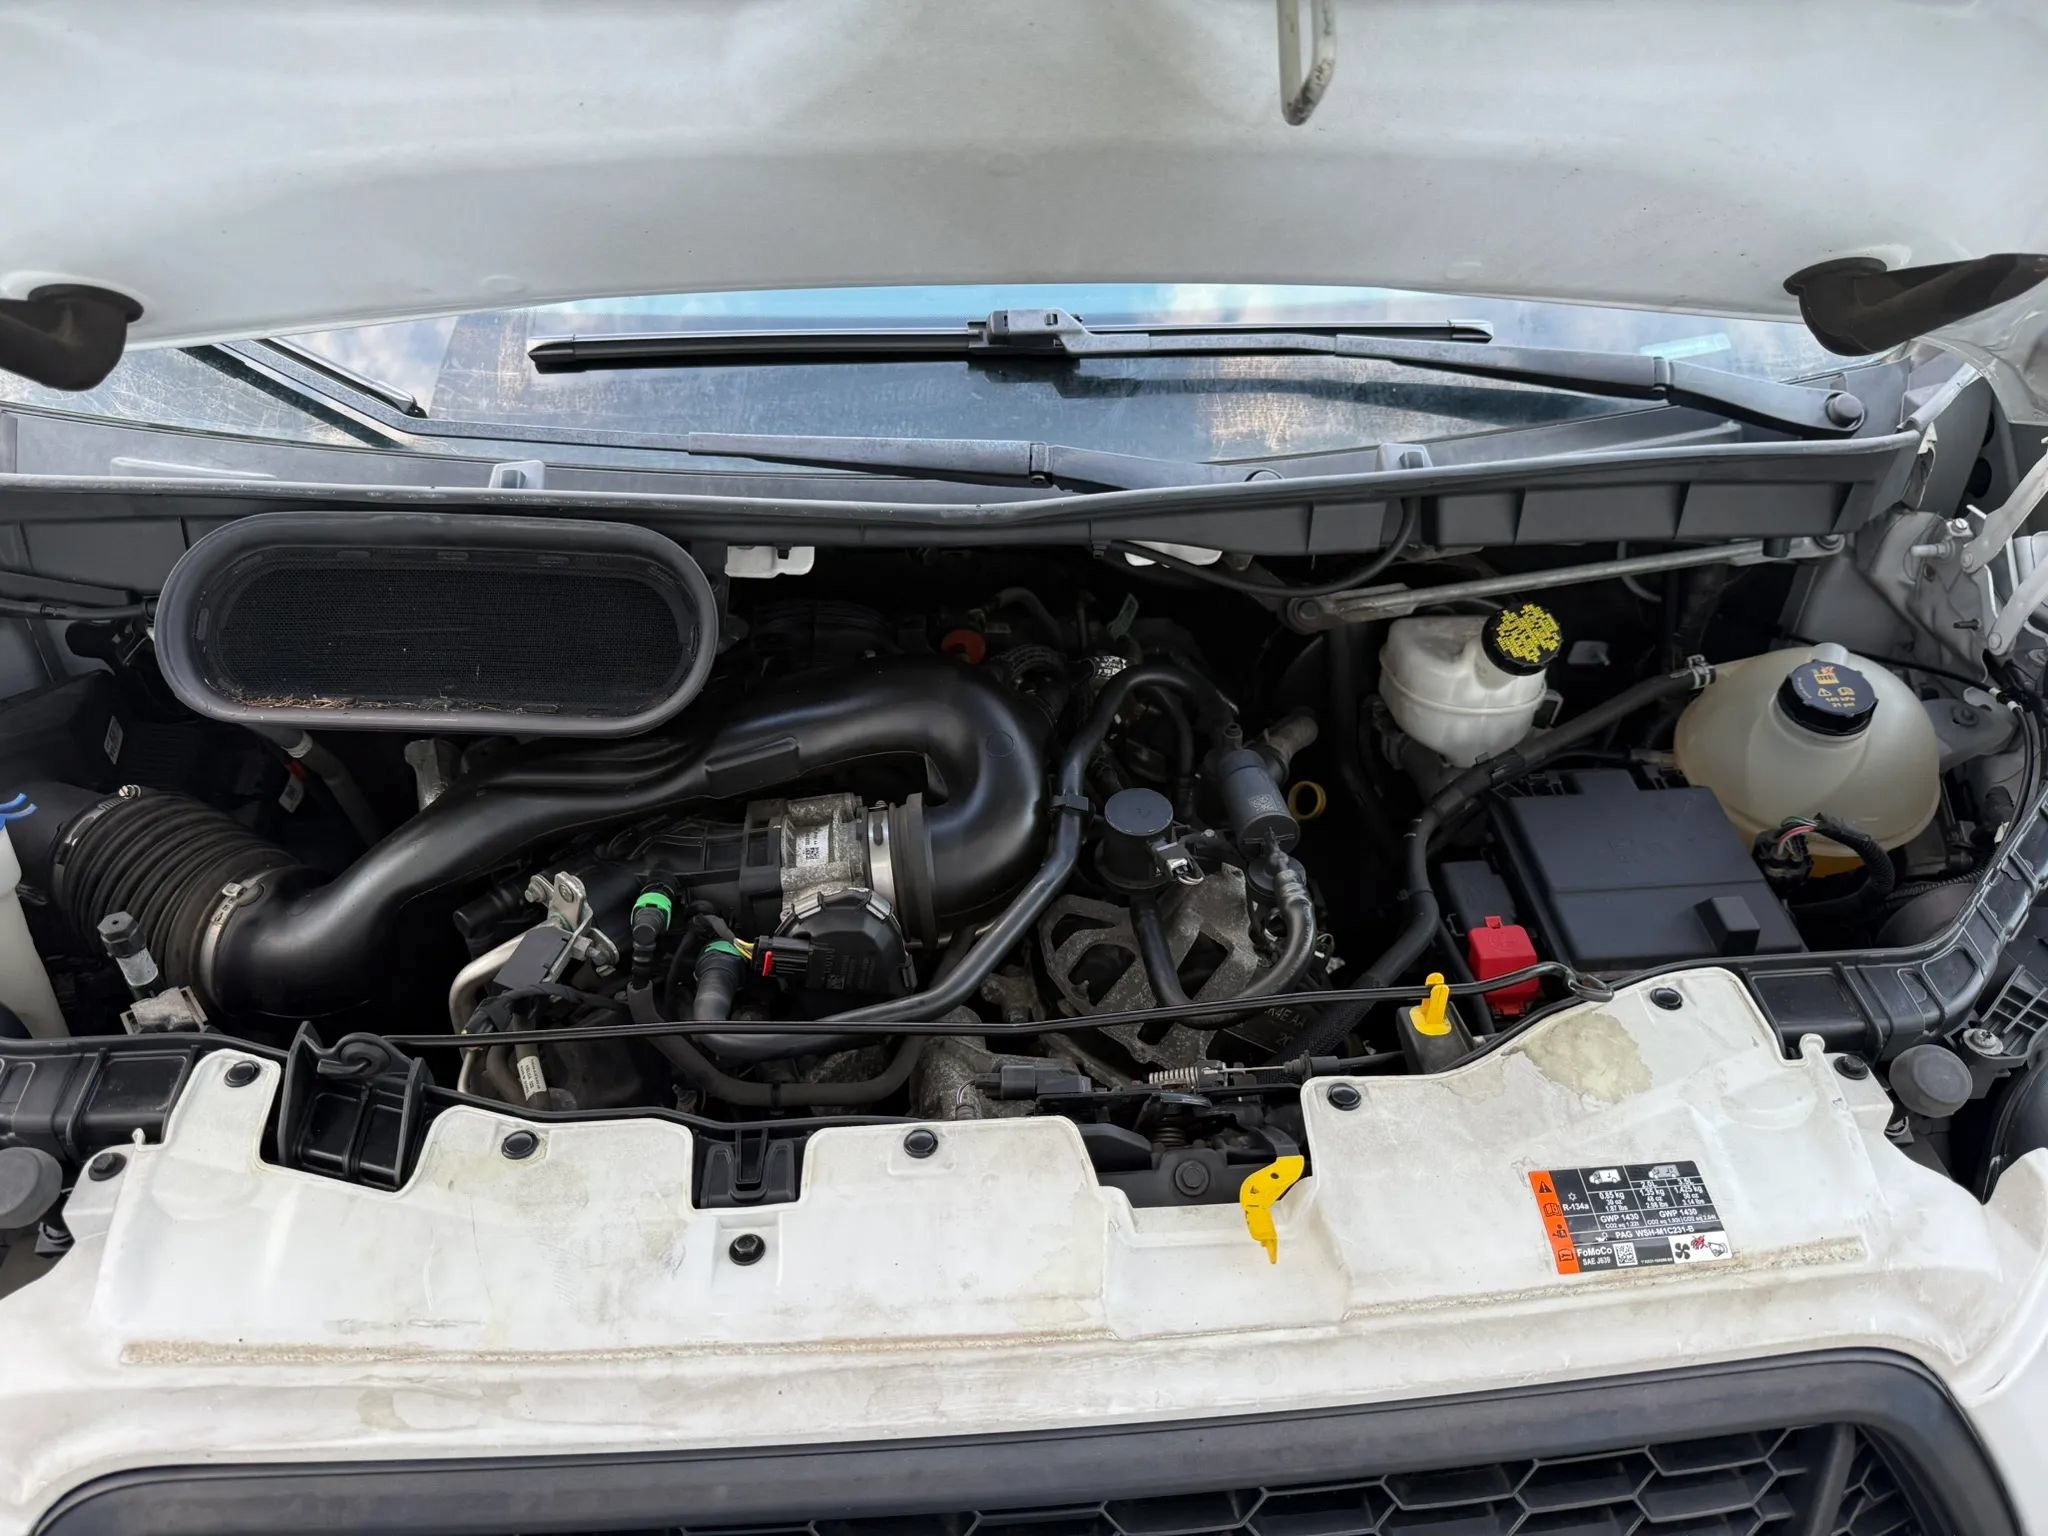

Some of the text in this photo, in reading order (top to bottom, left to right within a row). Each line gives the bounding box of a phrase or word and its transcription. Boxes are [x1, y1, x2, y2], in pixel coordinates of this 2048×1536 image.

[1655, 1186, 1665, 1196] kg
[1674, 1184, 1703, 1194] 1.425 kg
[1615, 1190, 1625, 1199] kg
[1562, 1203, 1589, 1212] R-134a
[1600, 1212, 1639, 1223] GWP 1430
[1658, 1208, 1698, 1218] GWP 1430
[1615, 1225, 1695, 1239] PAG WSH-M1C231-B
[1577, 1247, 1613, 1257] FoMoCo
[1582, 1258, 1595, 1266] SAE
